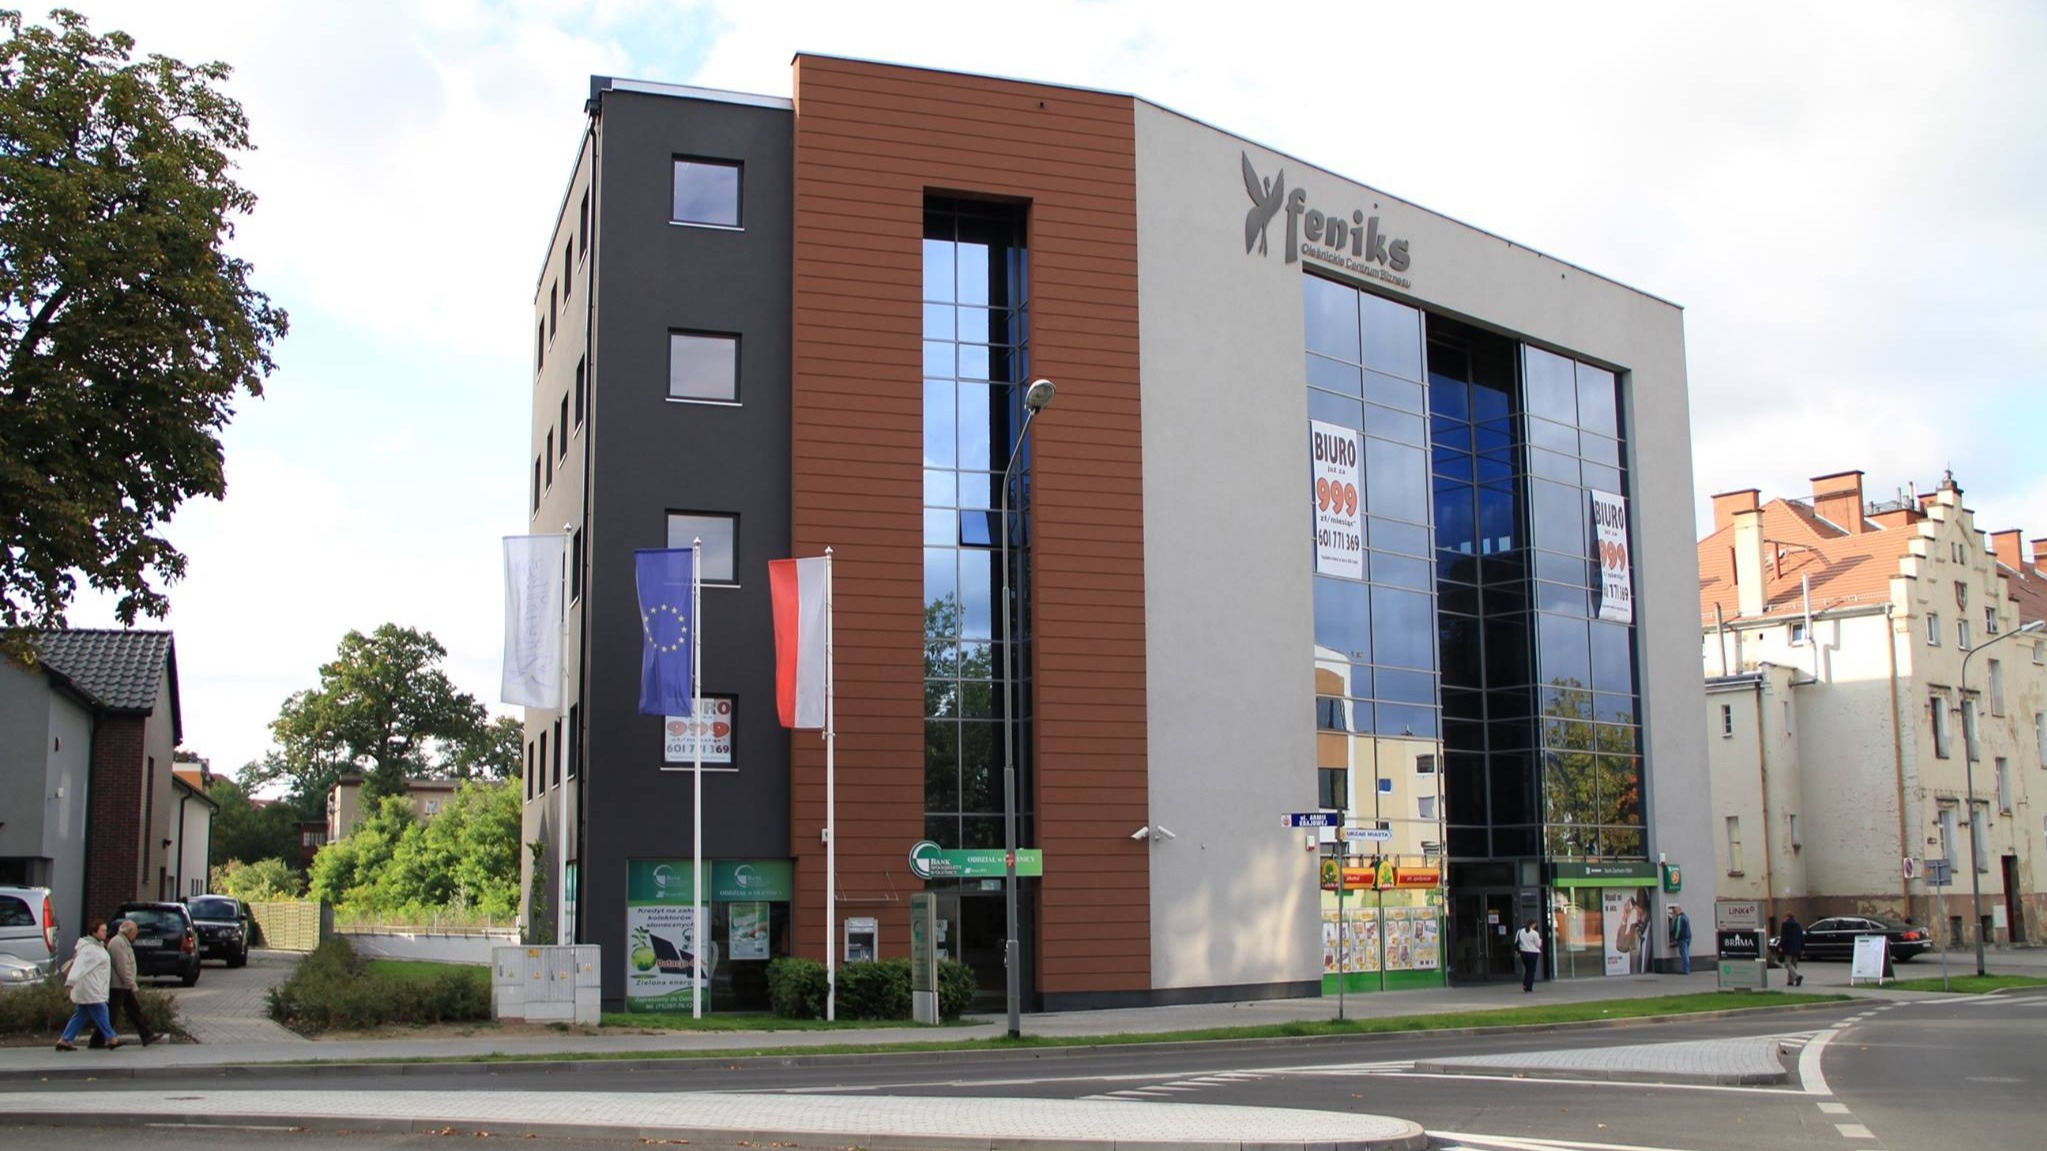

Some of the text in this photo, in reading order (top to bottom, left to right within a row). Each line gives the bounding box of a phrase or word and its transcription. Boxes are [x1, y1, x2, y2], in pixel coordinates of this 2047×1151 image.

[1285, 187, 1411, 272] feniks
[1346, 257, 1381, 278] Centrum
[1380, 269, 1412, 290] Biznesu
[1314, 431, 1357, 468] BIURO
[1316, 477, 1358, 517] 999
[1595, 501, 1625, 530] BIURO
[1318, 529, 1360, 552] 601 771 369
[666, 743, 685, 753] 601
[689, 743, 706, 753] 71
[637, 907, 664, 915] Kredyt
[1729, 907, 1750, 915] LINK4
[1724, 934, 1754, 947] BRAMA
